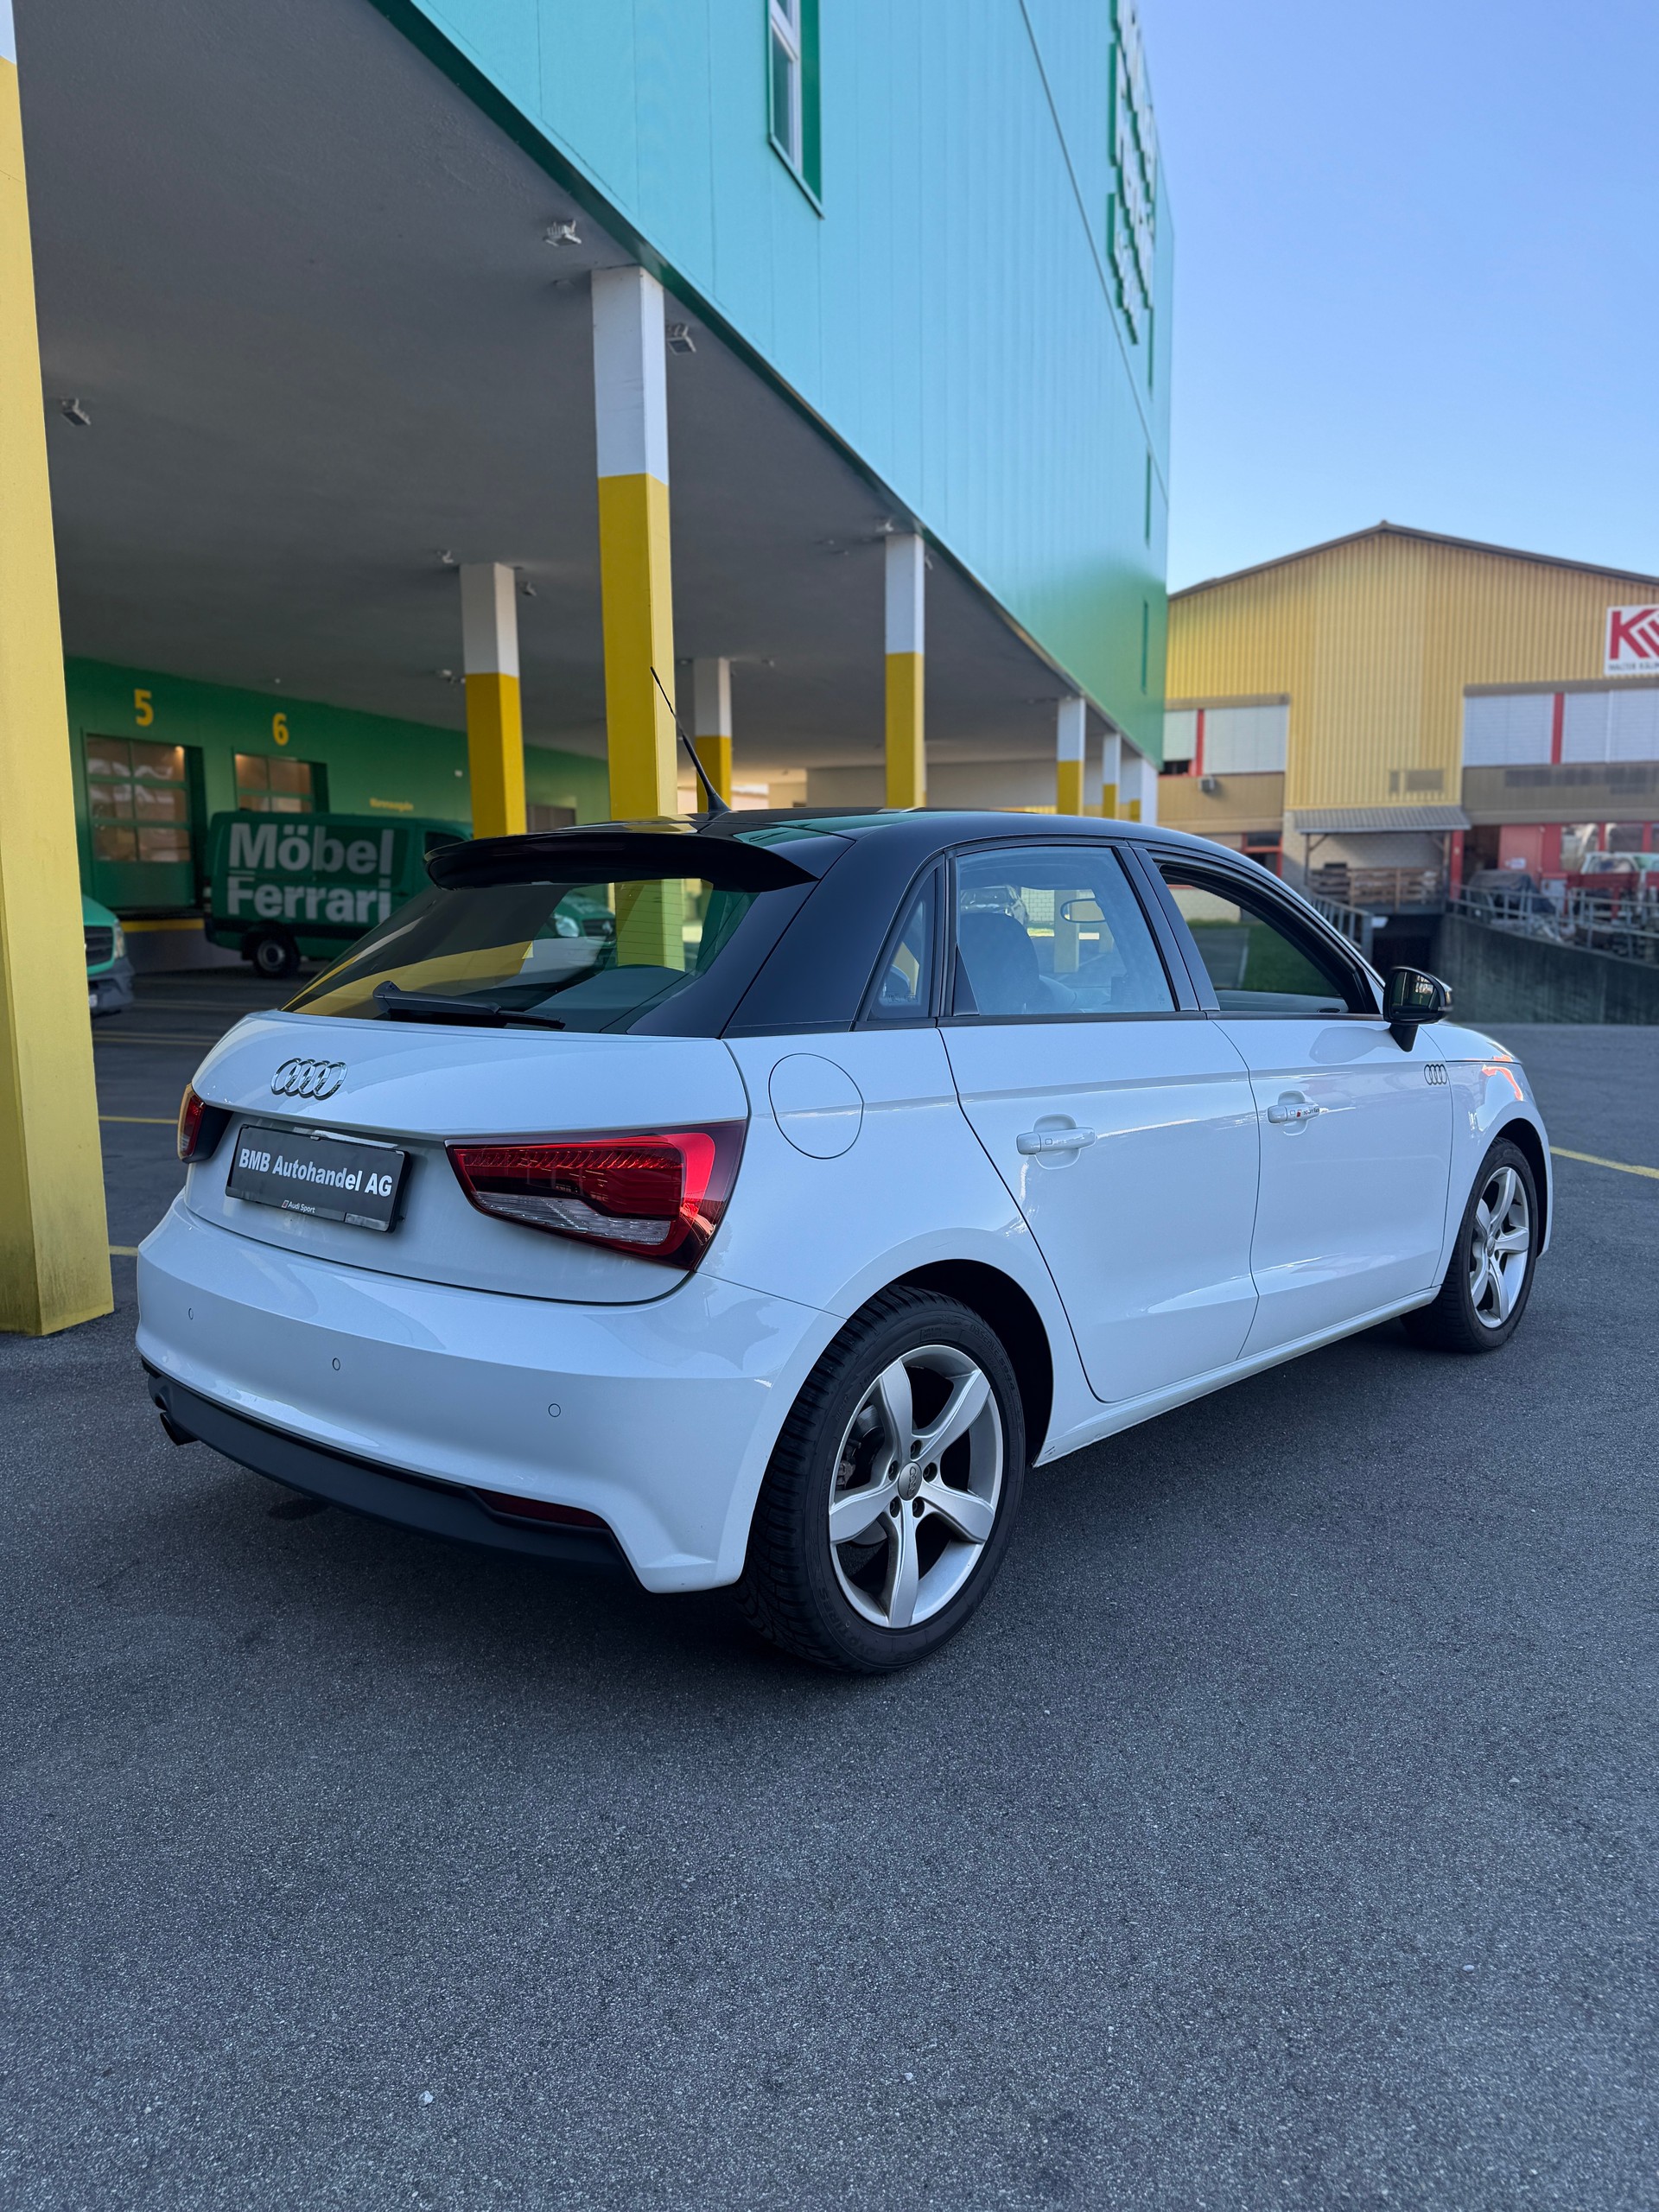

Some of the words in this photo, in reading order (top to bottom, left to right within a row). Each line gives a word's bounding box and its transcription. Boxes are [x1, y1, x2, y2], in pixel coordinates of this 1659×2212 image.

[134, 689, 154, 727] 5
[272, 712, 289, 746] 6
[228, 823, 394, 875] Möbel
[227, 870, 391, 924] Ferrari
[238, 1148, 270, 1173] BMB
[272, 1155, 363, 1191] Autohandel
[364, 1173, 393, 1197] AG
[288, 1201, 301, 1211] Audi
[300, 1203, 315, 1214] Sport
